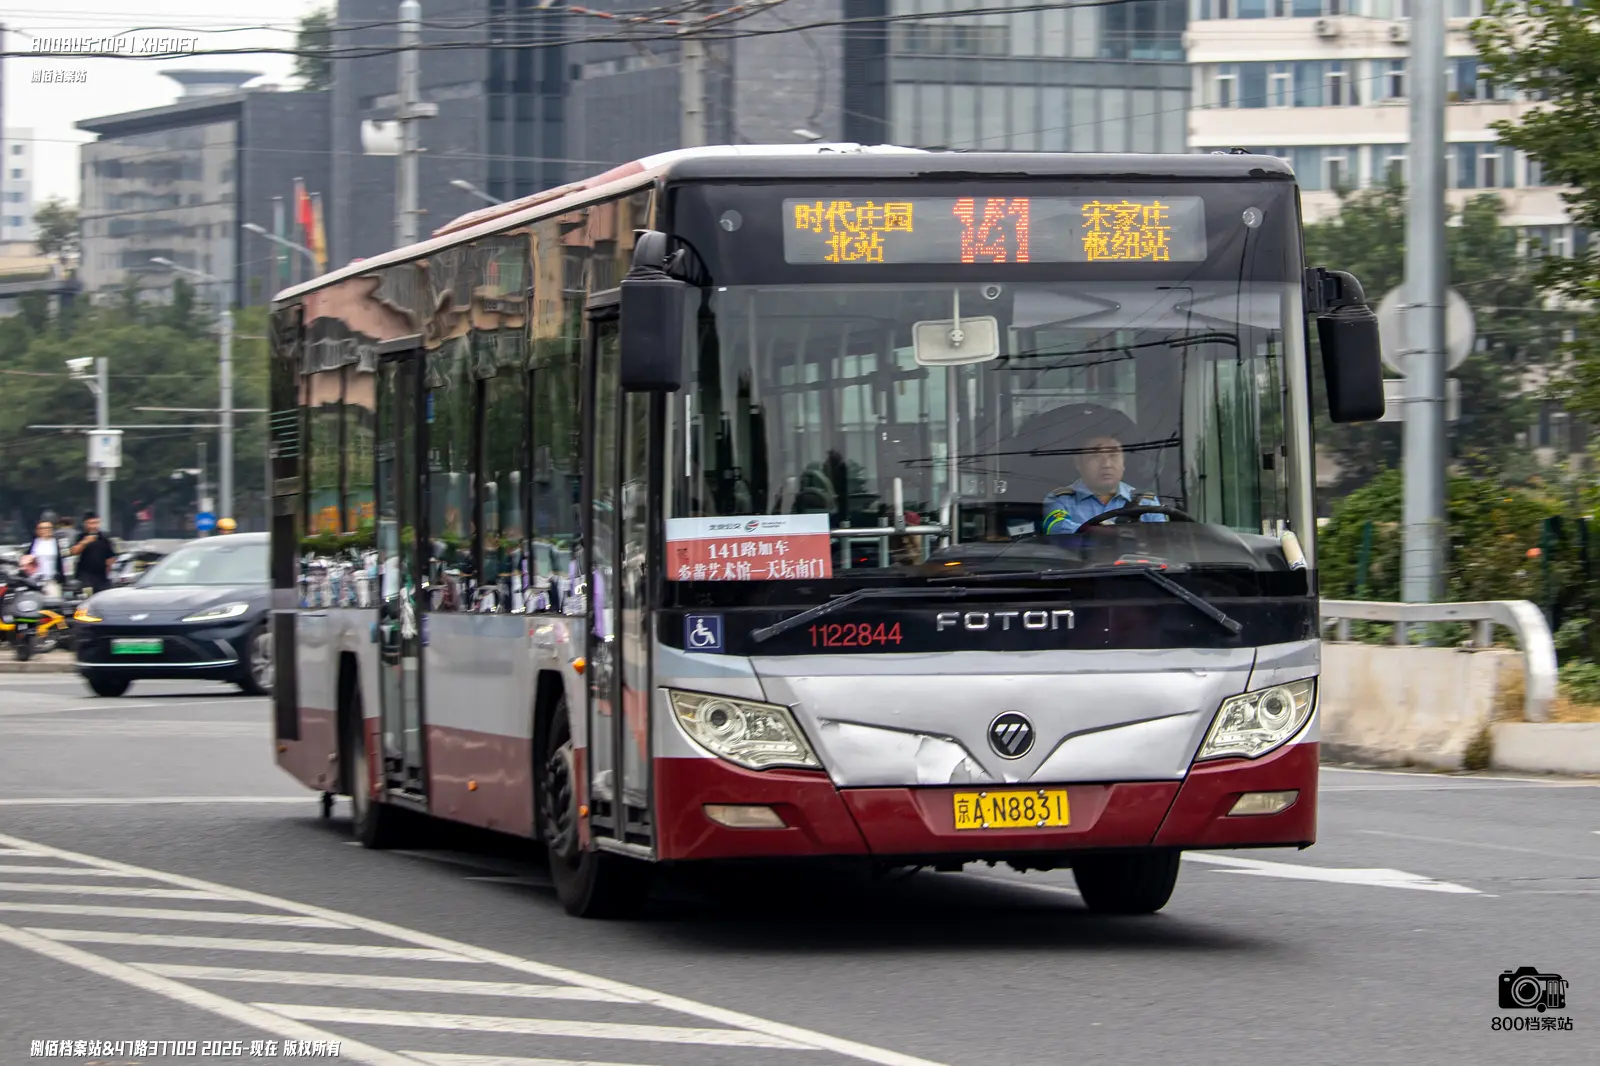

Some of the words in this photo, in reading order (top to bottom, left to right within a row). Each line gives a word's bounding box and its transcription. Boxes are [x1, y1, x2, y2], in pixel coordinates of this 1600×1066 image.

[795, 201, 914, 232] 时代庄园
[953, 198, 1030, 264] 141
[1081, 200, 1171, 231] 宋家庄
[824, 231, 885, 263] 北站
[1081, 230, 1171, 262] 枢纽站
[708, 540, 790, 560] 141路加车
[808, 622, 903, 647] 1122844
[936, 609, 1076, 632] FOTON
